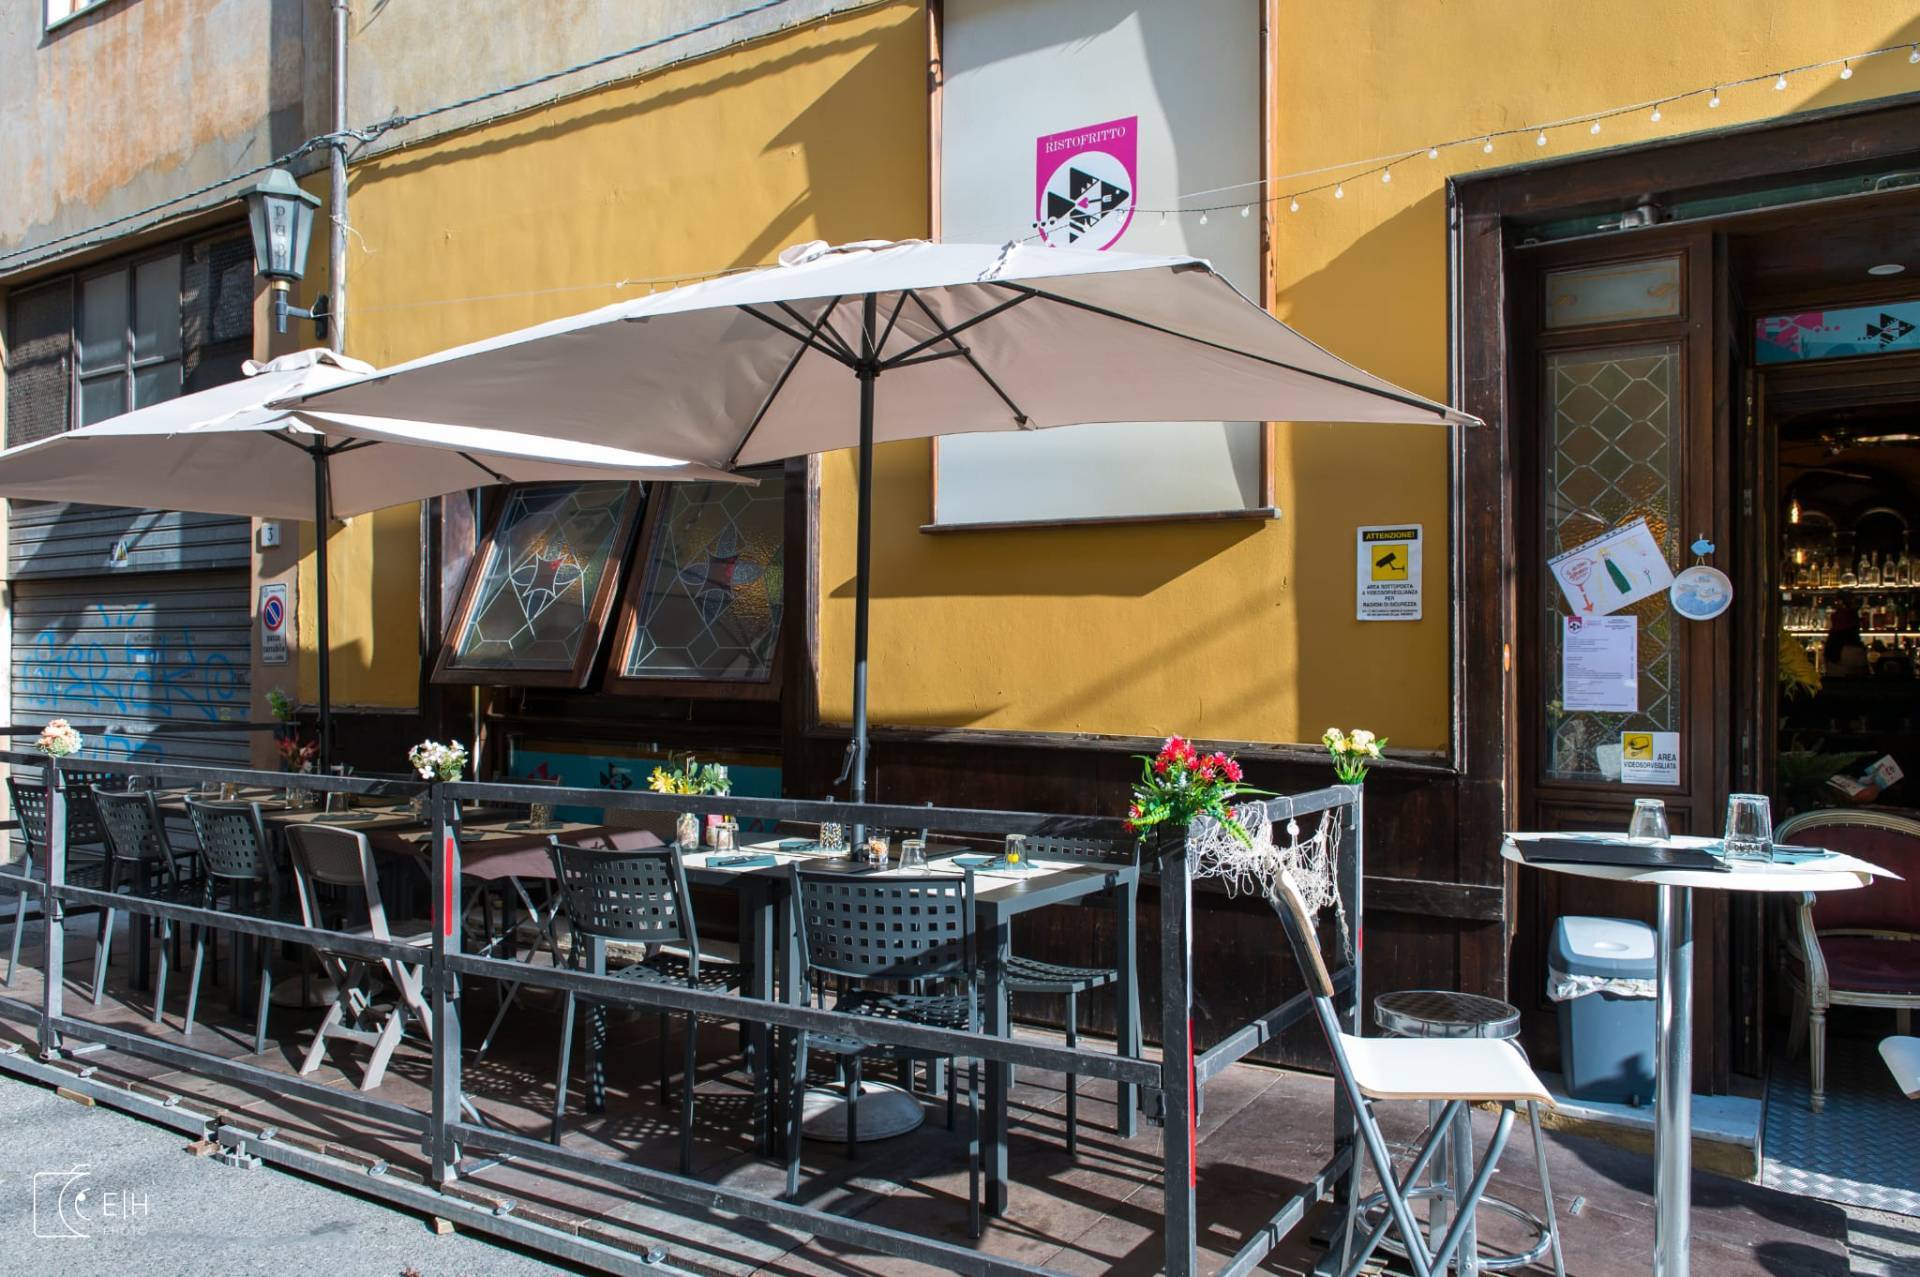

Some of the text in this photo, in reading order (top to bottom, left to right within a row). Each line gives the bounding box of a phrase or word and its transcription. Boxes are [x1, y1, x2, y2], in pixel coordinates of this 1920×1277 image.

[1045, 126, 1126, 153] RISTOFRITTO
[266, 527, 273, 542] 3
[1365, 531, 1415, 540] ATTENZIONE!
[1657, 753, 1676, 761] AREA
[1624, 761, 1676, 769] VIDEOSORVEGLIATA
